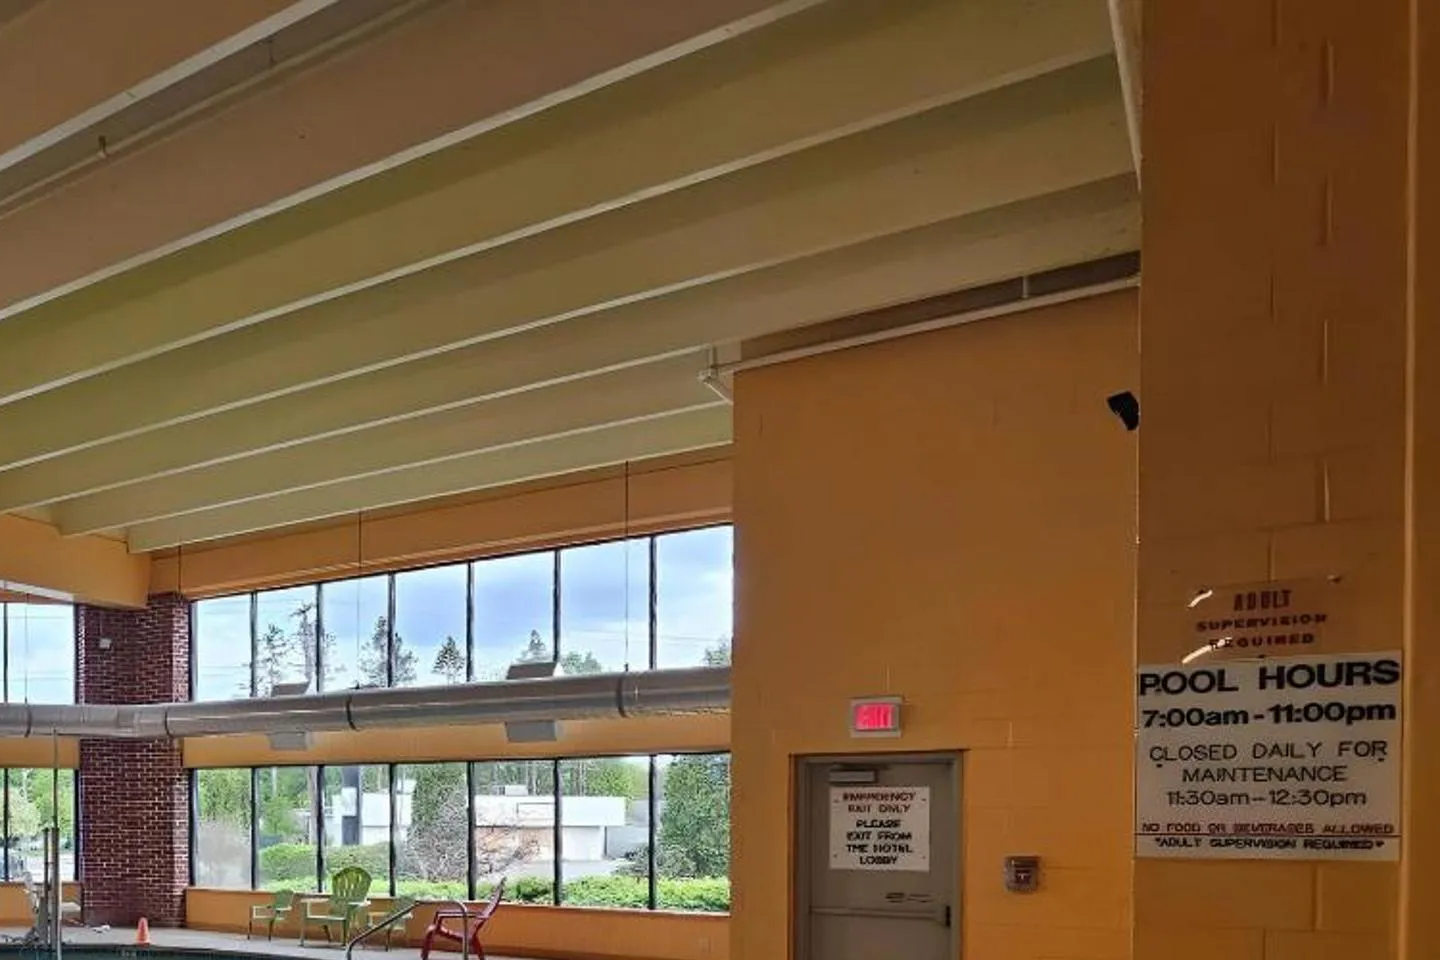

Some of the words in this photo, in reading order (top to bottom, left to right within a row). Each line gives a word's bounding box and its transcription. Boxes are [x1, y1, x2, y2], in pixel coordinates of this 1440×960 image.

[1234, 590, 1292, 611] ADULT
[1196, 613, 1328, 632] SUPERVISION
[1209, 633, 1314, 648] REQUIRED
[1139, 668, 1238, 696] POOL
[1259, 660, 1400, 690] HOURS
[1149, 744, 1238, 761] CLOSED
[1252, 742, 1323, 759] DAILY
[1338, 740, 1388, 757] FOR
[1182, 765, 1348, 783] MAINTENANCE
[878, 804, 911, 813] ONLY
[877, 831, 912, 840] FROM
[1142, 823, 1160, 832] NO
[1166, 823, 1201, 832] FOOD
[1208, 823, 1226, 833] OR
[1322, 824, 1395, 834] ALLOWED
[846, 844, 869, 853] THE
[1209, 838, 1297, 849] SUPERVISION
